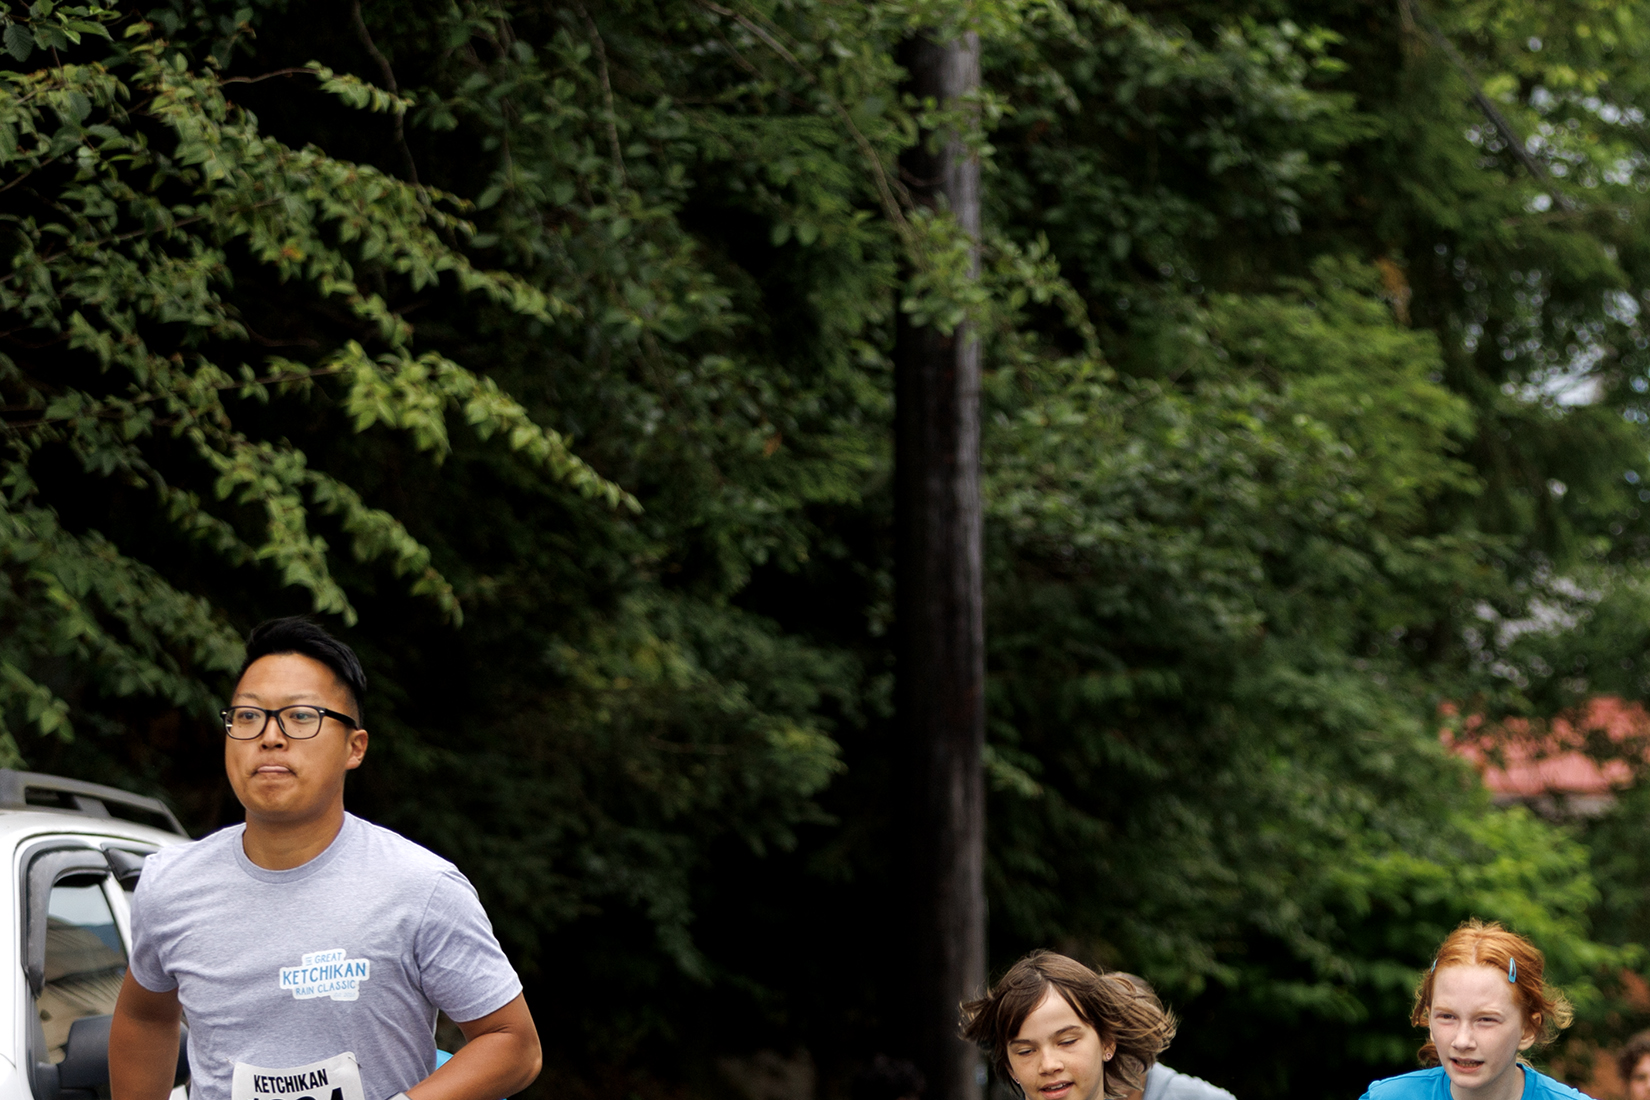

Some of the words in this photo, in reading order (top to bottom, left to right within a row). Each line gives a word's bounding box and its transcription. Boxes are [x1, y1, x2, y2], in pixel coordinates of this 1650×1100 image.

[314, 952, 342, 964] GREAT
[282, 962, 366, 985] KETCHIKAN
[295, 986, 315, 996] RAIN
[317, 980, 356, 993] CLASSIC
[253, 1068, 329, 1094] KETCHIKAN
